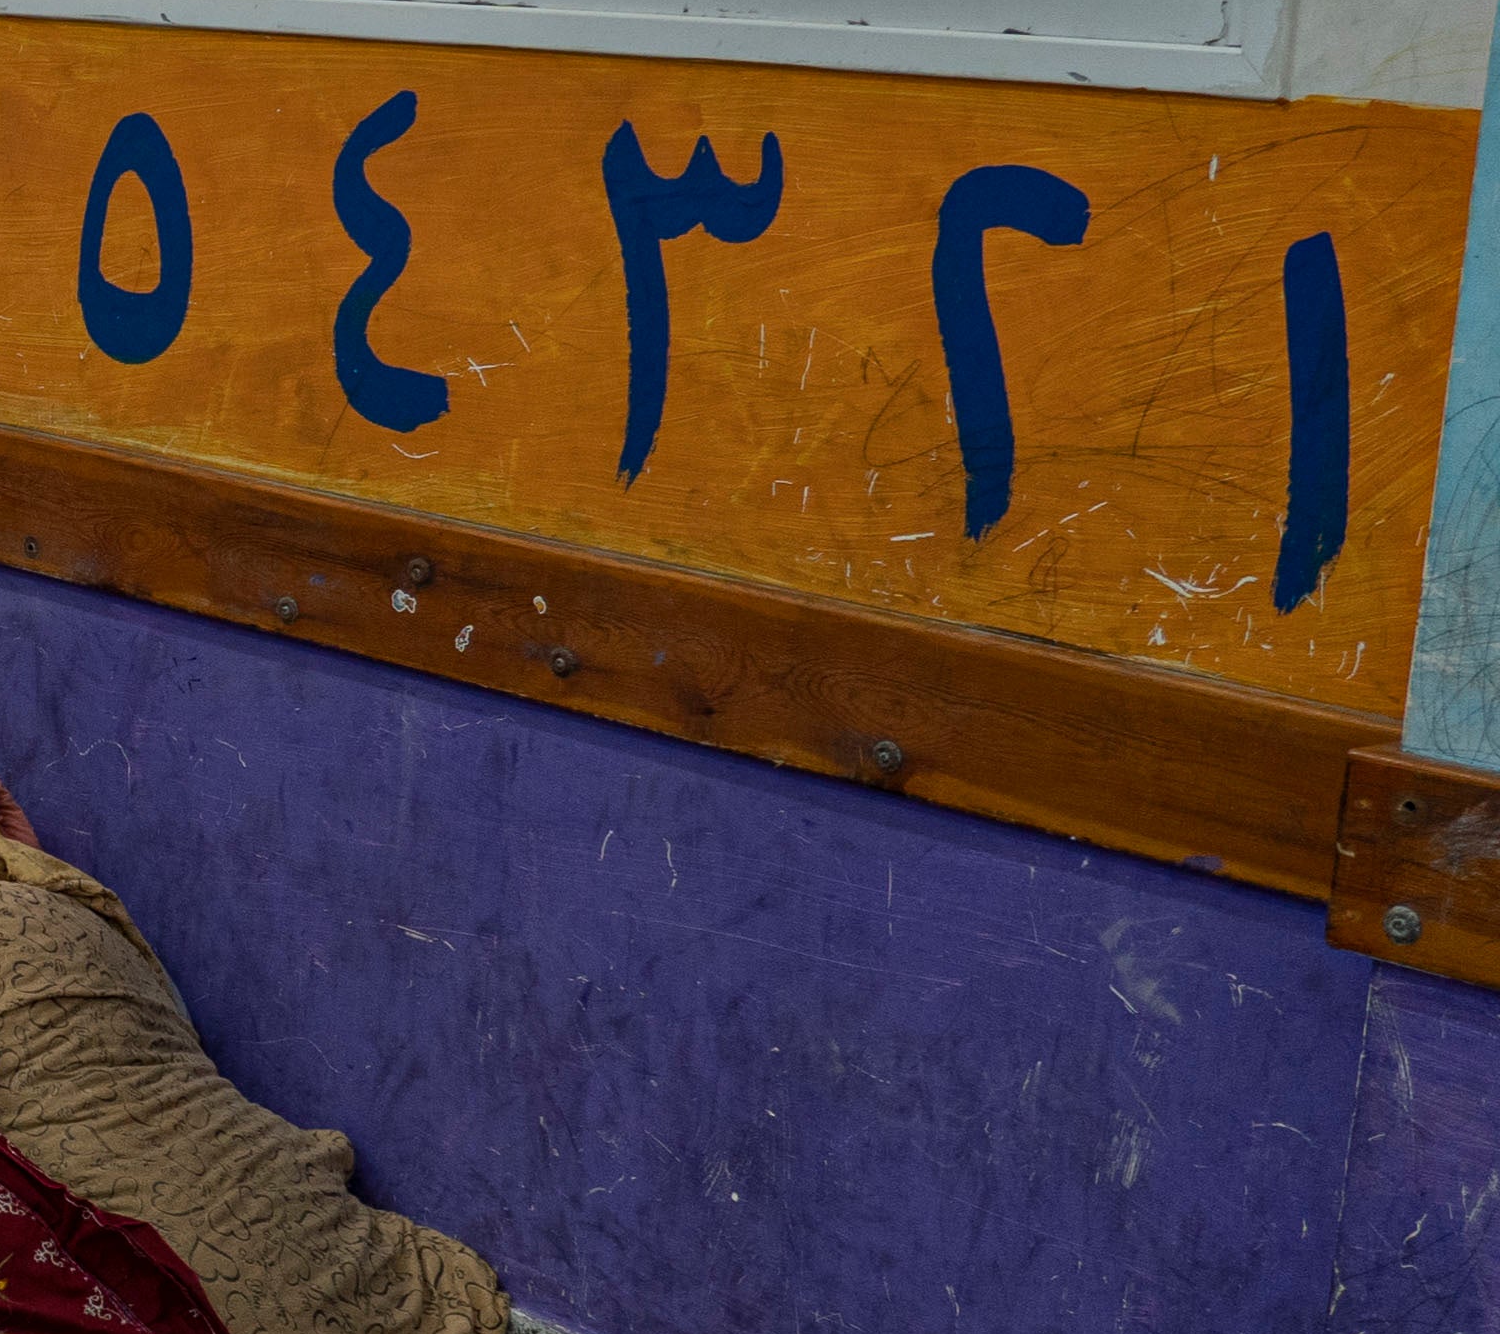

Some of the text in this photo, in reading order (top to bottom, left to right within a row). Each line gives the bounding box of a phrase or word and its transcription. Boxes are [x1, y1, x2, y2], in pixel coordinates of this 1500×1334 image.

[79, 113, 192, 364] ٥
[334, 91, 448, 433] ٤
[603, 121, 782, 485] ٣
[933, 166, 1089, 541] ٢
[1275, 233, 1349, 612] ١
